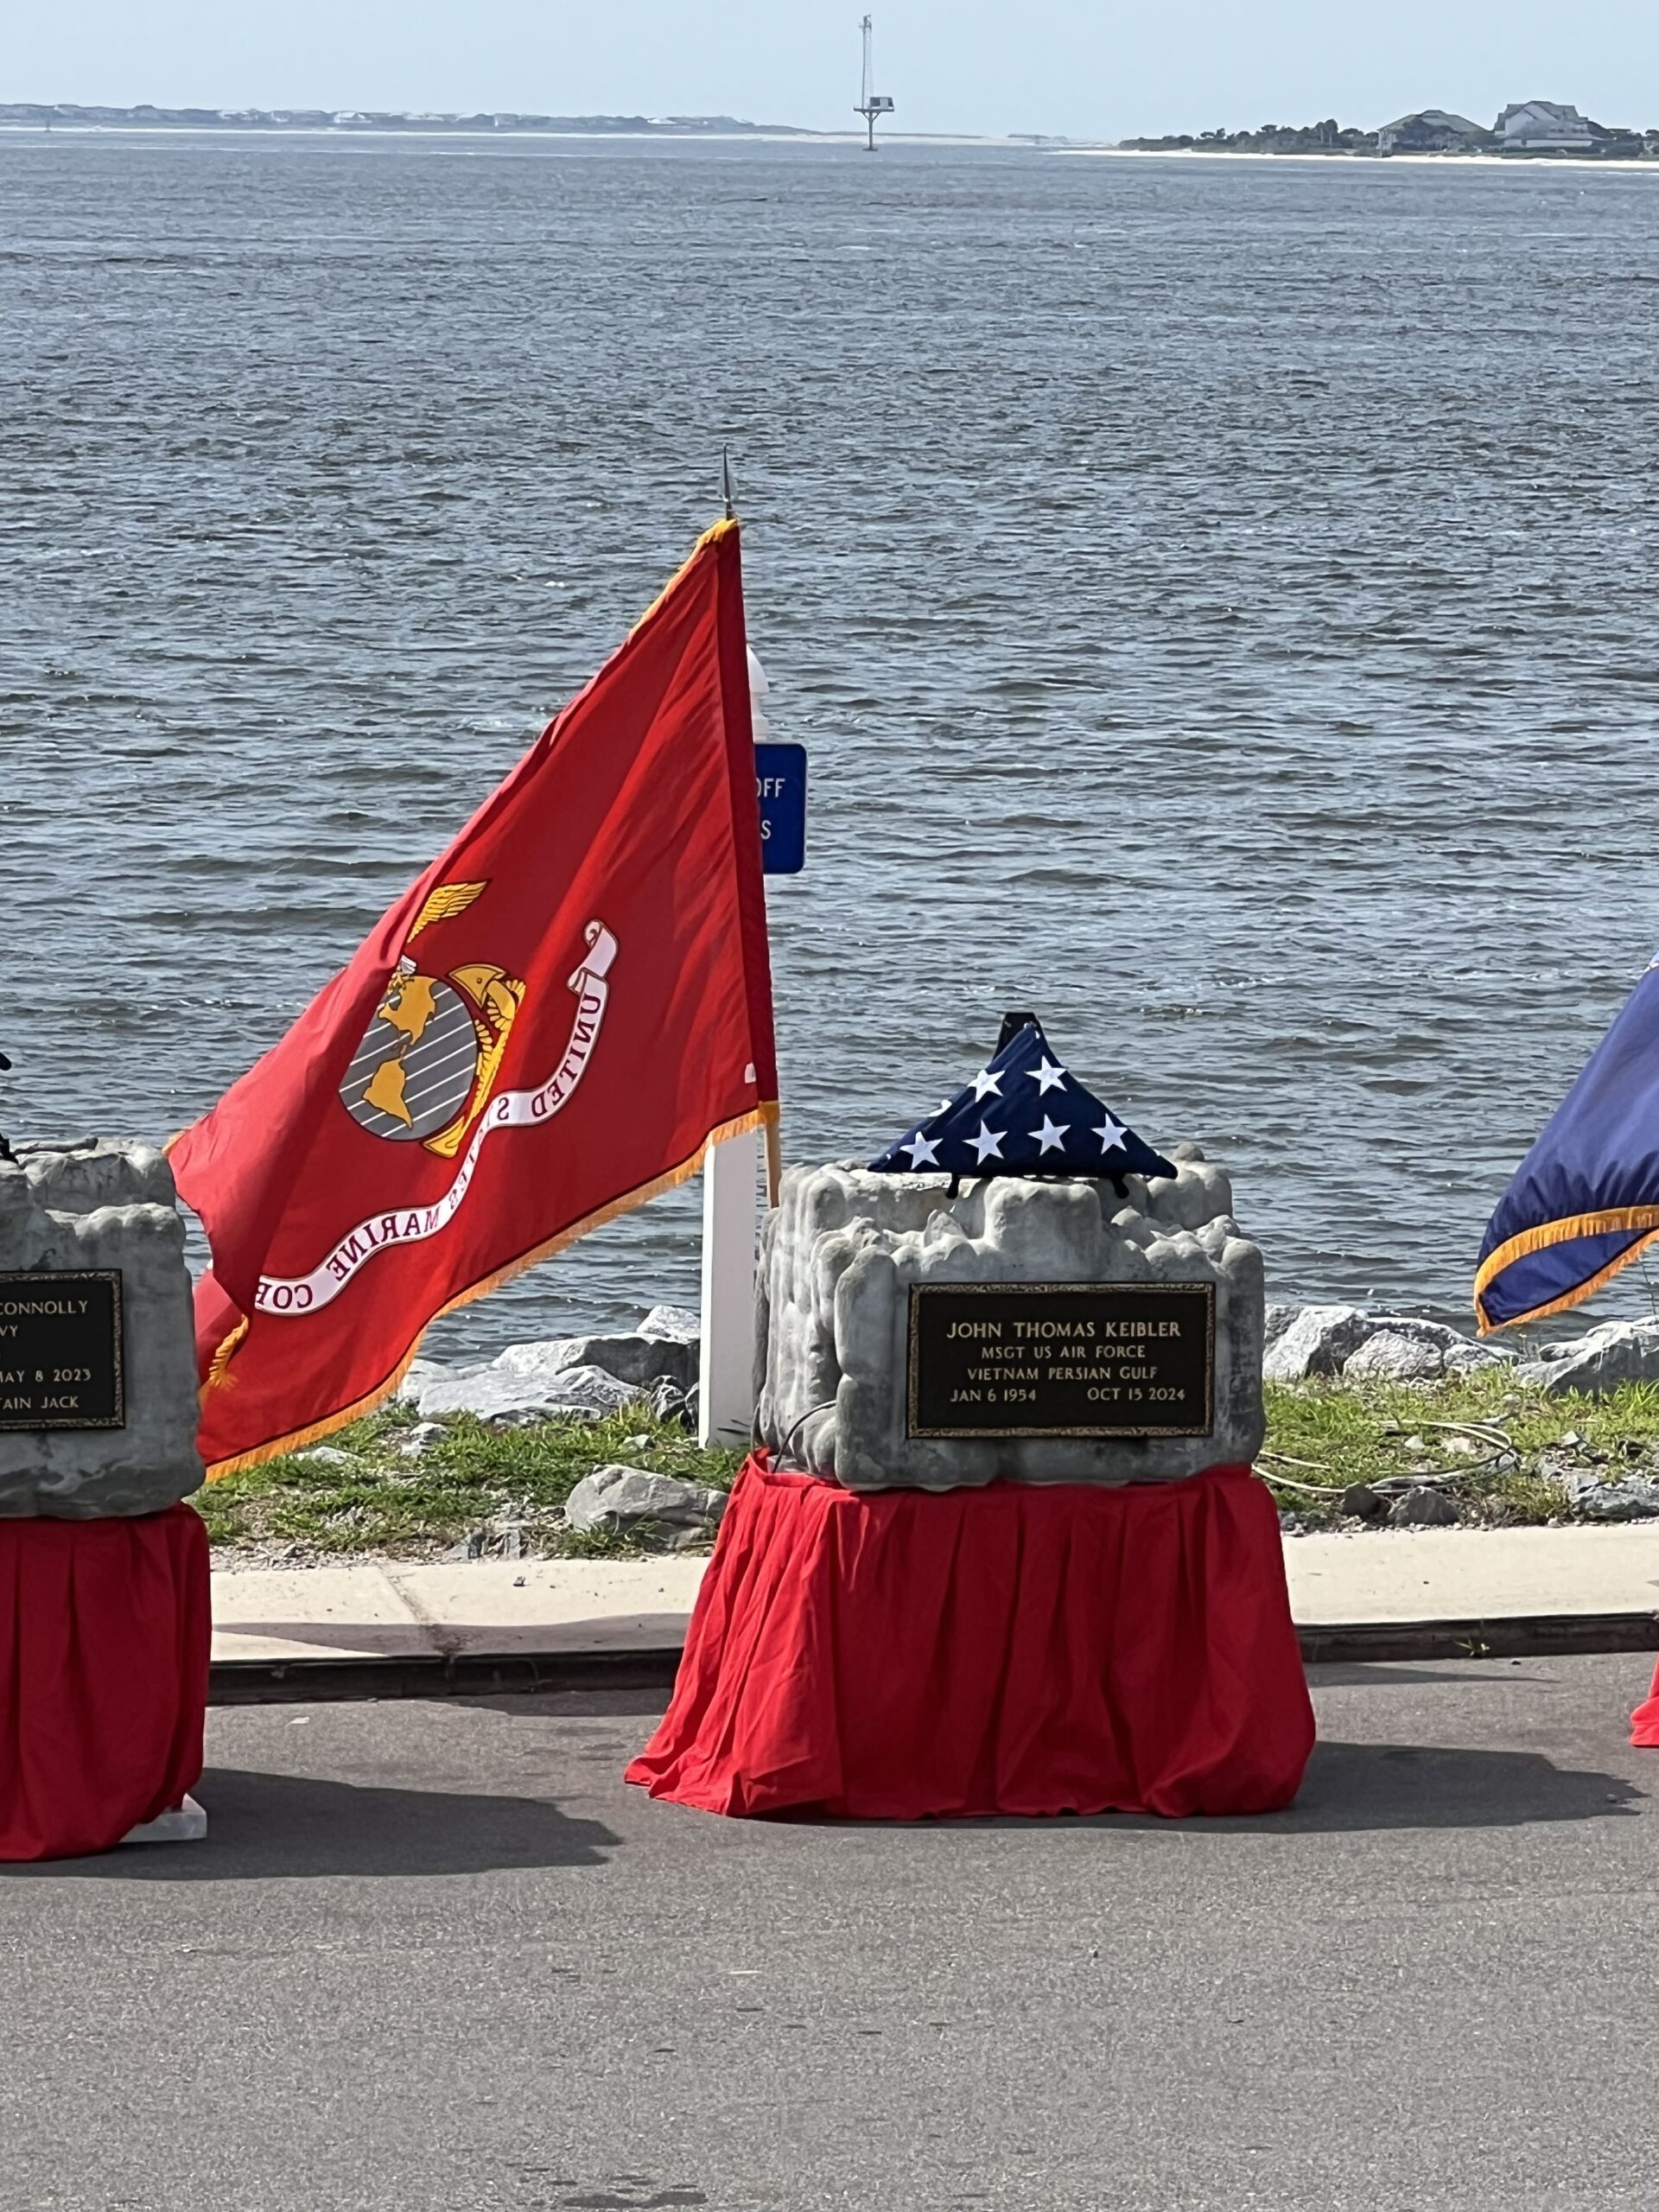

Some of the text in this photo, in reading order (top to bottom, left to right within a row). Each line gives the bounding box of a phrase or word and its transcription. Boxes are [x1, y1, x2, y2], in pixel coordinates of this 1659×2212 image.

[946, 1321, 1181, 1338] JOHN THOMAS KEIBLER
[982, 1344, 1146, 1359] MSGT US AIR FORCE
[35, 1370, 43, 1382] 8
[54, 1368, 92, 1382] 2023
[967, 1366, 1157, 1381] VIETNAM PERSIAN GULF
[41, 1395, 79, 1408] JACK
[950, 1387, 1185, 1402] JAN 6 1954 OCT 15 2024
